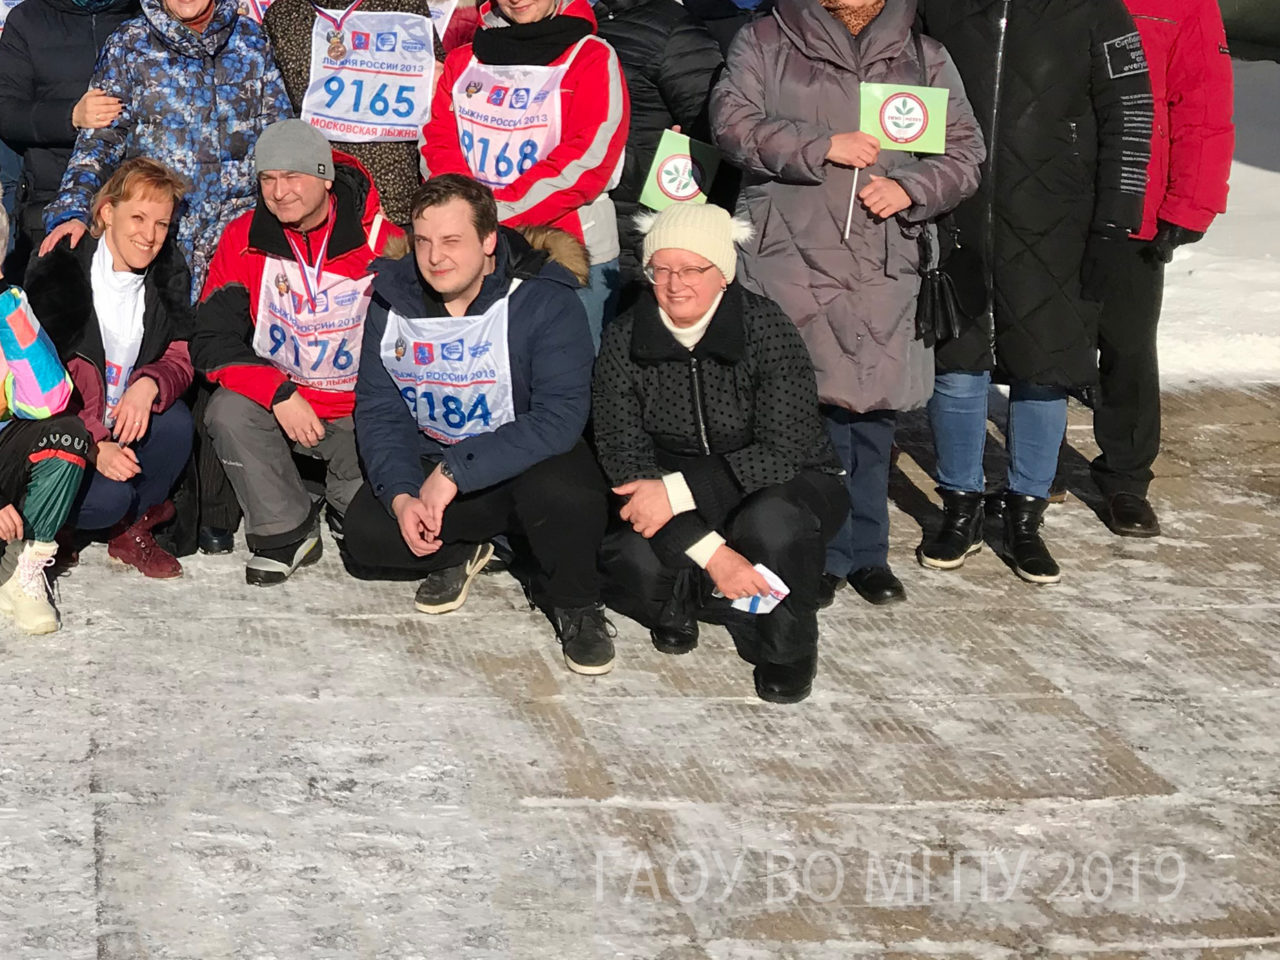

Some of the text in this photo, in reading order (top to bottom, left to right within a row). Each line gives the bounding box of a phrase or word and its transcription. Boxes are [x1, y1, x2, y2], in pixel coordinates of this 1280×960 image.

[360, 60, 399, 71] РОССИИ
[400, 64, 425, 72] 2013
[323, 76, 416, 118] 9165
[310, 117, 418, 138] МОСКОВСКАЯ ЛЫЖНЯ
[524, 114, 548, 125] 2013
[461, 129, 538, 178] 9168
[269, 324, 353, 371] 9176
[400, 386, 492, 429] 9184
